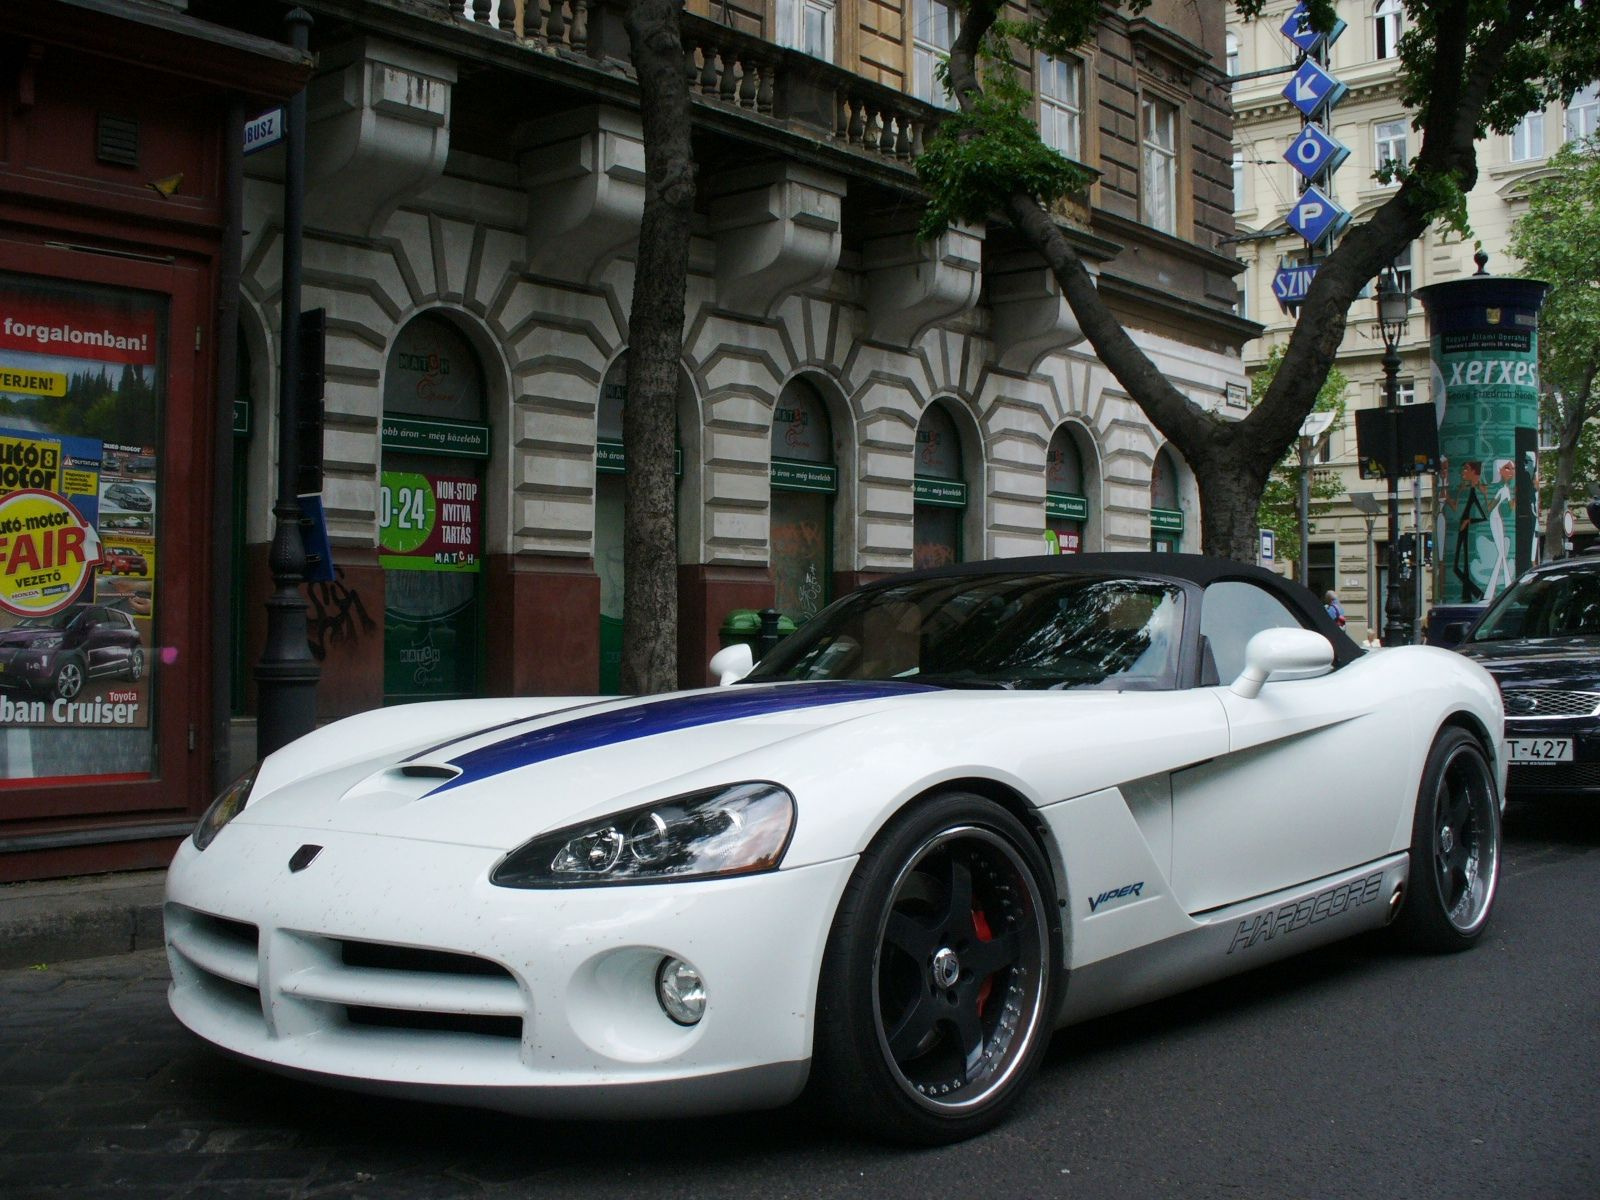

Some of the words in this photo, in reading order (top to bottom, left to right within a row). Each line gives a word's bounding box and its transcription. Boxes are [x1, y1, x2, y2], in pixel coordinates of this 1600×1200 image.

[3, 317, 147, 350] forgalomban!
[0, 372, 53, 391] ERJEN!
[1448, 361, 1535, 386] xerxes
[400, 428, 419, 439] áron
[429, 431, 445, 443] még
[447, 433, 481, 444] közelebb
[0, 465, 56, 490] otor
[436, 481, 478, 501] NON-STOP
[380, 486, 425, 529] 0-24
[442, 503, 472, 523] NYITVA
[442, 522, 472, 544] TARTÁS
[434, 551, 474, 564] MATCH
[12, 590, 39, 599] HONDA
[400, 646, 440, 663] MATCH
[109, 691, 137, 702] Toyota
[0, 695, 45, 723] ban
[52, 696, 139, 724] Cruiser
[1507, 741, 1567, 758] T-427
[1088, 881, 1145, 913] VIPER
[1226, 872, 1384, 954] HARDCORE
